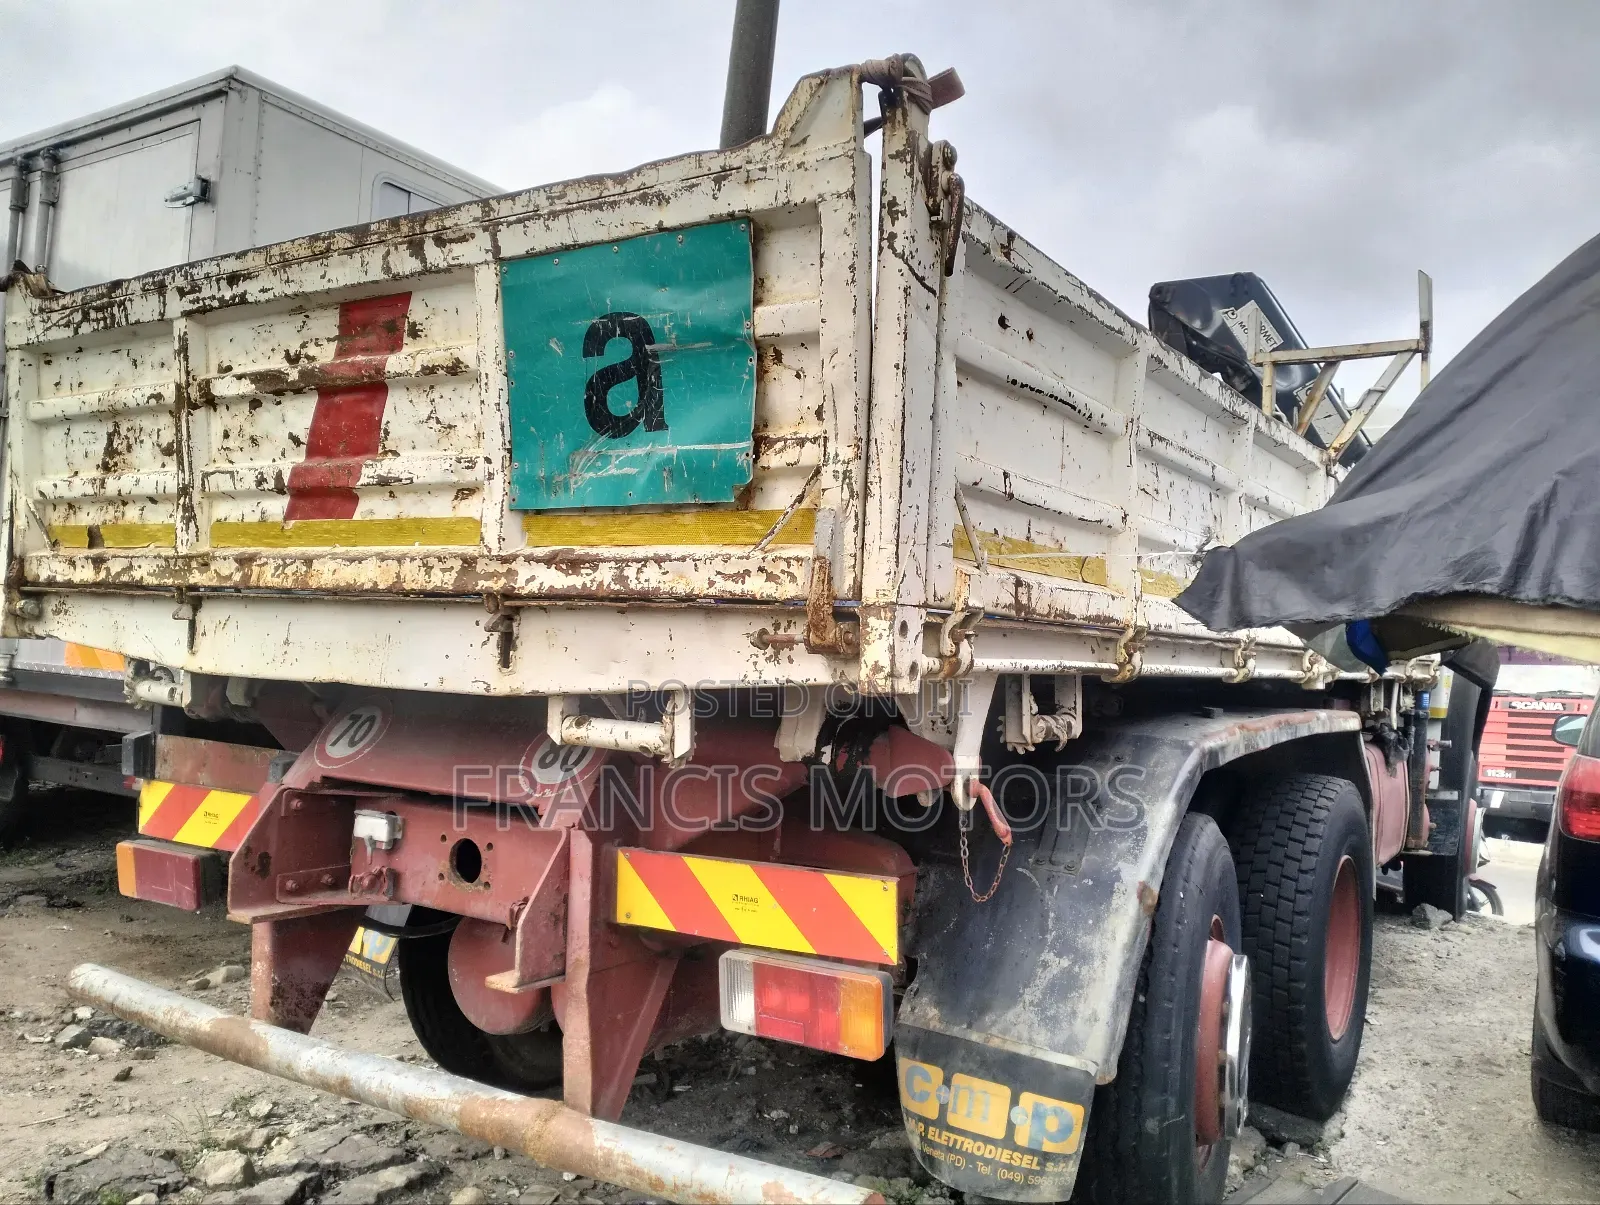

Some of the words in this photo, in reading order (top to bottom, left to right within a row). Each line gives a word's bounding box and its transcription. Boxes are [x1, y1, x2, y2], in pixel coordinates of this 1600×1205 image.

[582, 311, 669, 440] a
[1510, 701, 1566, 711] SCANIA
[329, 713, 377, 749] 70
[927, 1127, 1041, 1171] ELETTRODIESEL
[946, 1152, 966, 1171] (PD)
[976, 1162, 993, 1176] Tel.
[997, 1168, 1025, 1184] (049)
